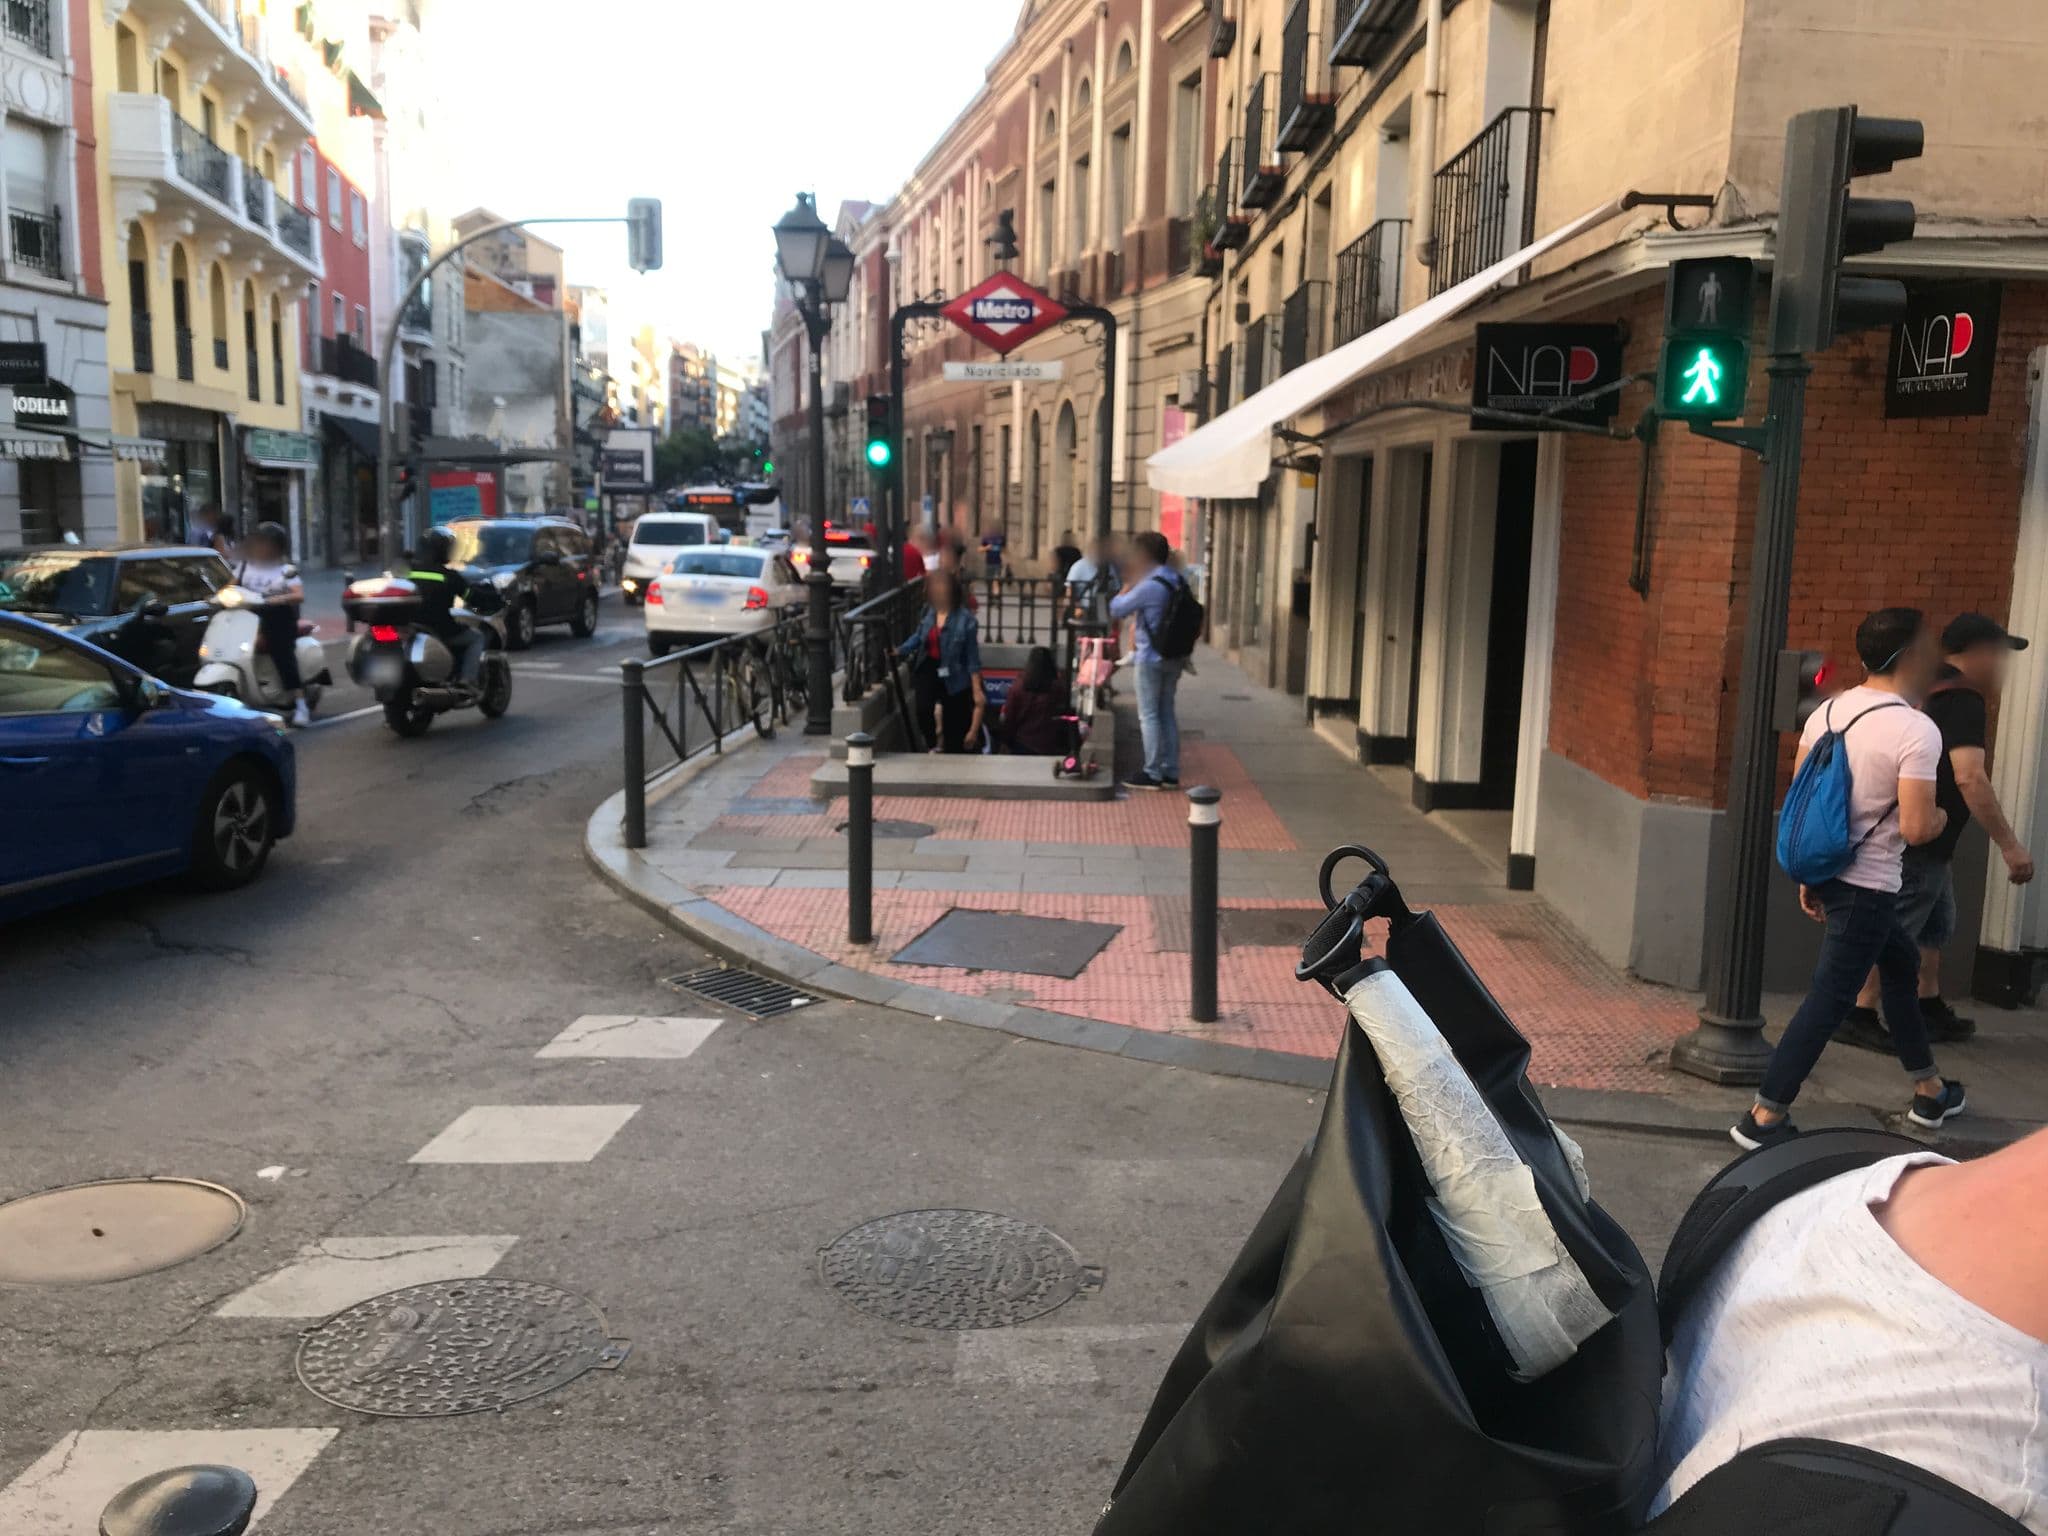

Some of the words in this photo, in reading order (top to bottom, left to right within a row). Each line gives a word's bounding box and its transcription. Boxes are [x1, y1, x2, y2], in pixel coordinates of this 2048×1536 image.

[976, 302, 1031, 319] Metro
[1488, 345, 1598, 396] NAP
[1898, 313, 1974, 377] NAP
